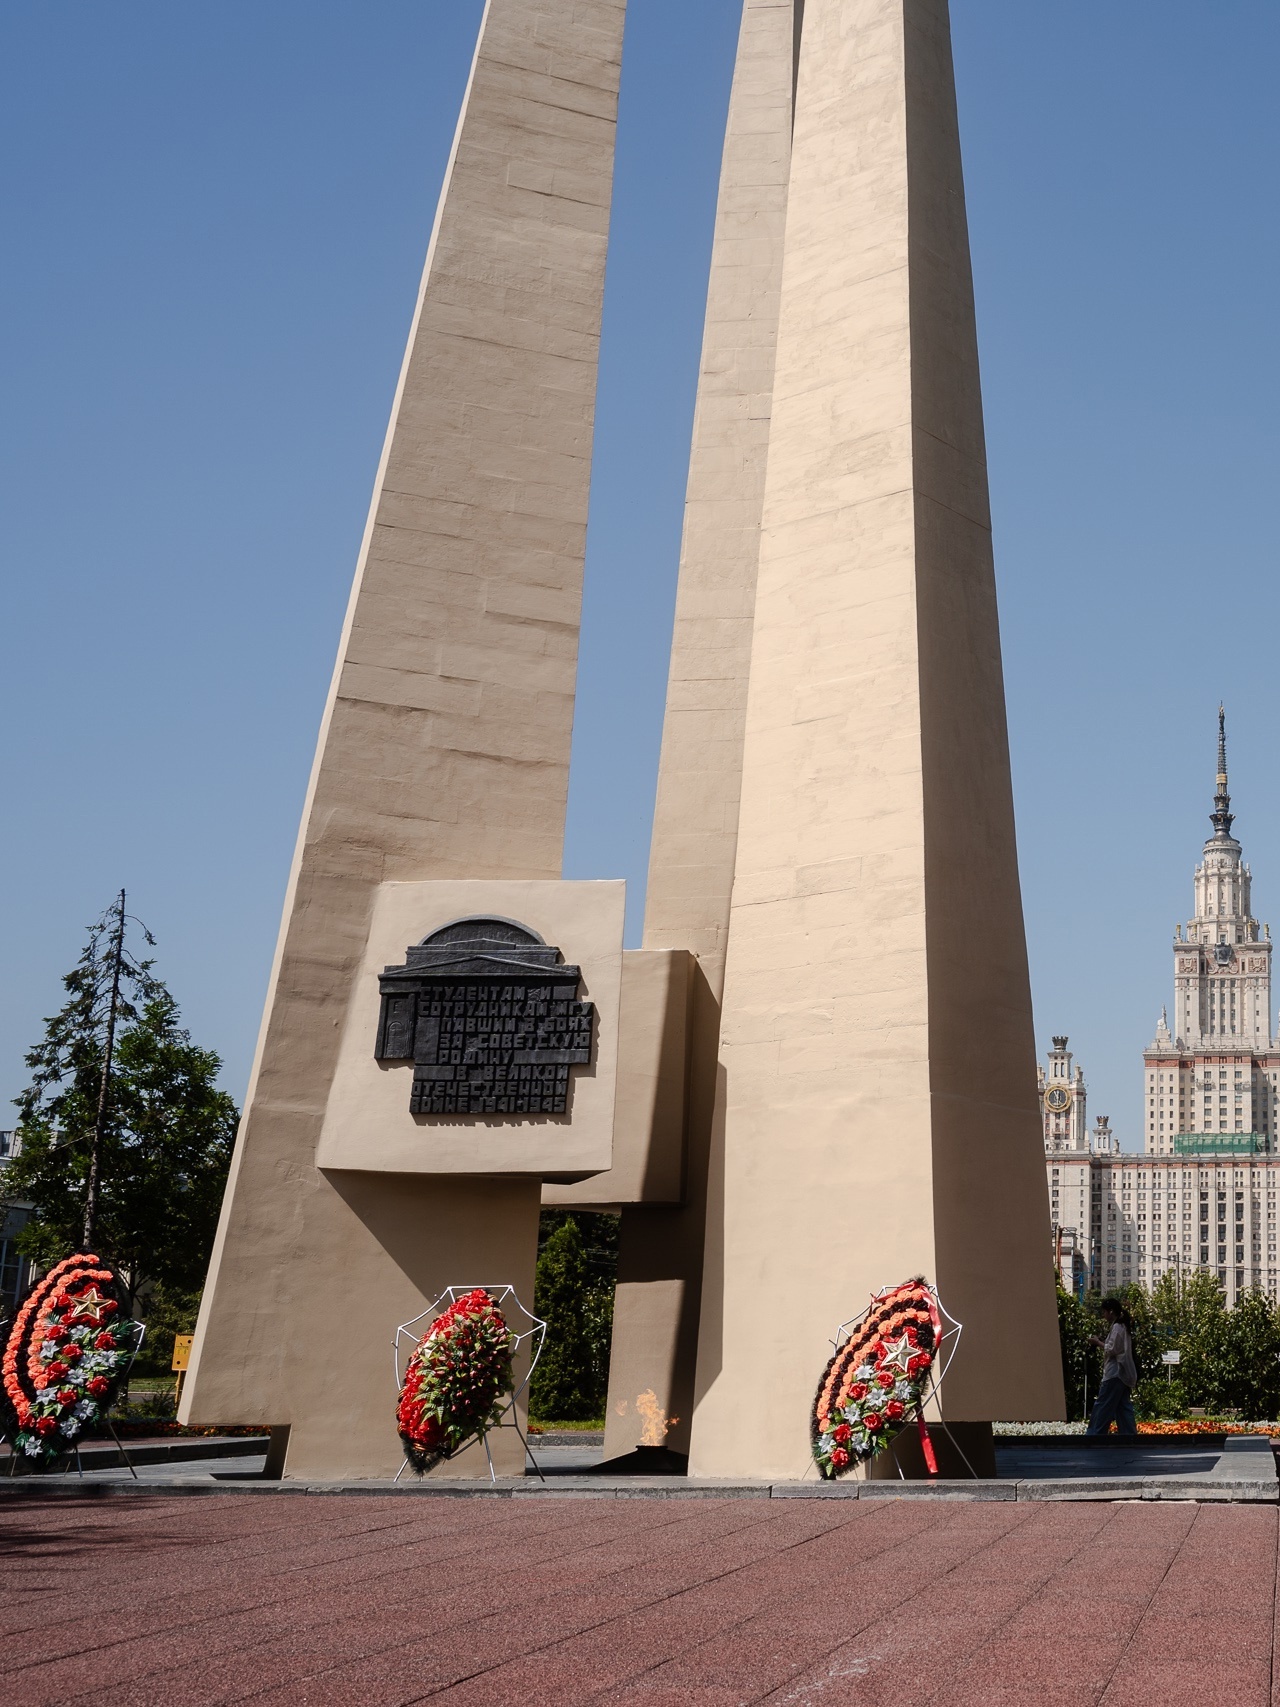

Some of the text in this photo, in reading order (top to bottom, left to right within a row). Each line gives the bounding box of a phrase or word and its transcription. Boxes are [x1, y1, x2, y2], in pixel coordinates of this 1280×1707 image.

[420, 986, 552, 1001] СТУДЕНТАМ И
[419, 1002, 592, 1016] СОТРУДНИКАМ МГУ
[441, 1017, 591, 1032] ПАВШИМ В БОЯХ
[440, 1033, 590, 1048] ЗА СОВЕТСКУЮ
[439, 1050, 513, 1064] РОДИНУ
[456, 1066, 467, 1080] В
